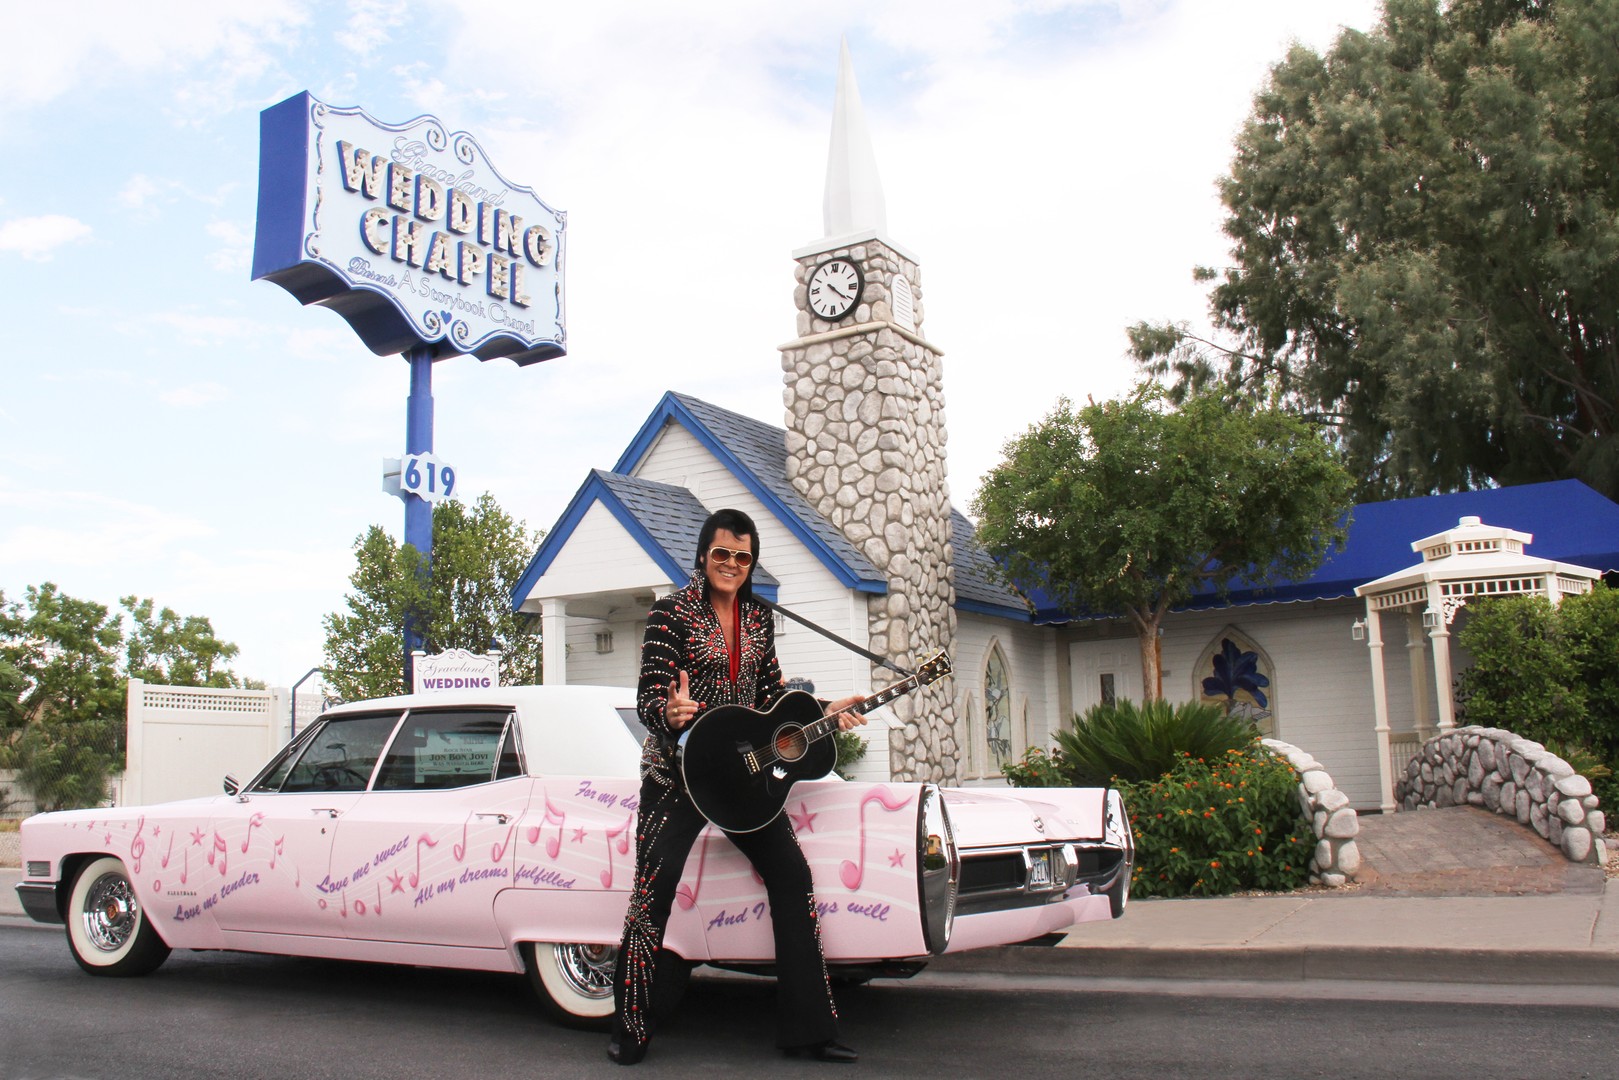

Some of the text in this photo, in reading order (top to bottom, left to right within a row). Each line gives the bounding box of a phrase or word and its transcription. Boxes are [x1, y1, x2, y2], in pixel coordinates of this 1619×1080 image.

[390, 136, 508, 207] Graceland
[336, 140, 552, 267] WEDDING
[359, 207, 531, 308] CHAPEL
[398, 270, 416, 293] A
[418, 277, 486, 319] Storybook
[487, 302, 535, 336] Chapel
[405, 458, 455, 497] 619
[423, 662, 489, 677] Graceland
[423, 677, 491, 689] WEDDING
[575, 781, 597, 799] For
[598, 793, 618, 808] my
[316, 835, 410, 894] Love me sweet
[414, 865, 575, 908] All my dreams fulfilled
[173, 871, 260, 922] Love me tender
[707, 906, 749, 931] And
[752, 902, 766, 920] I
[847, 902, 892, 921] will
